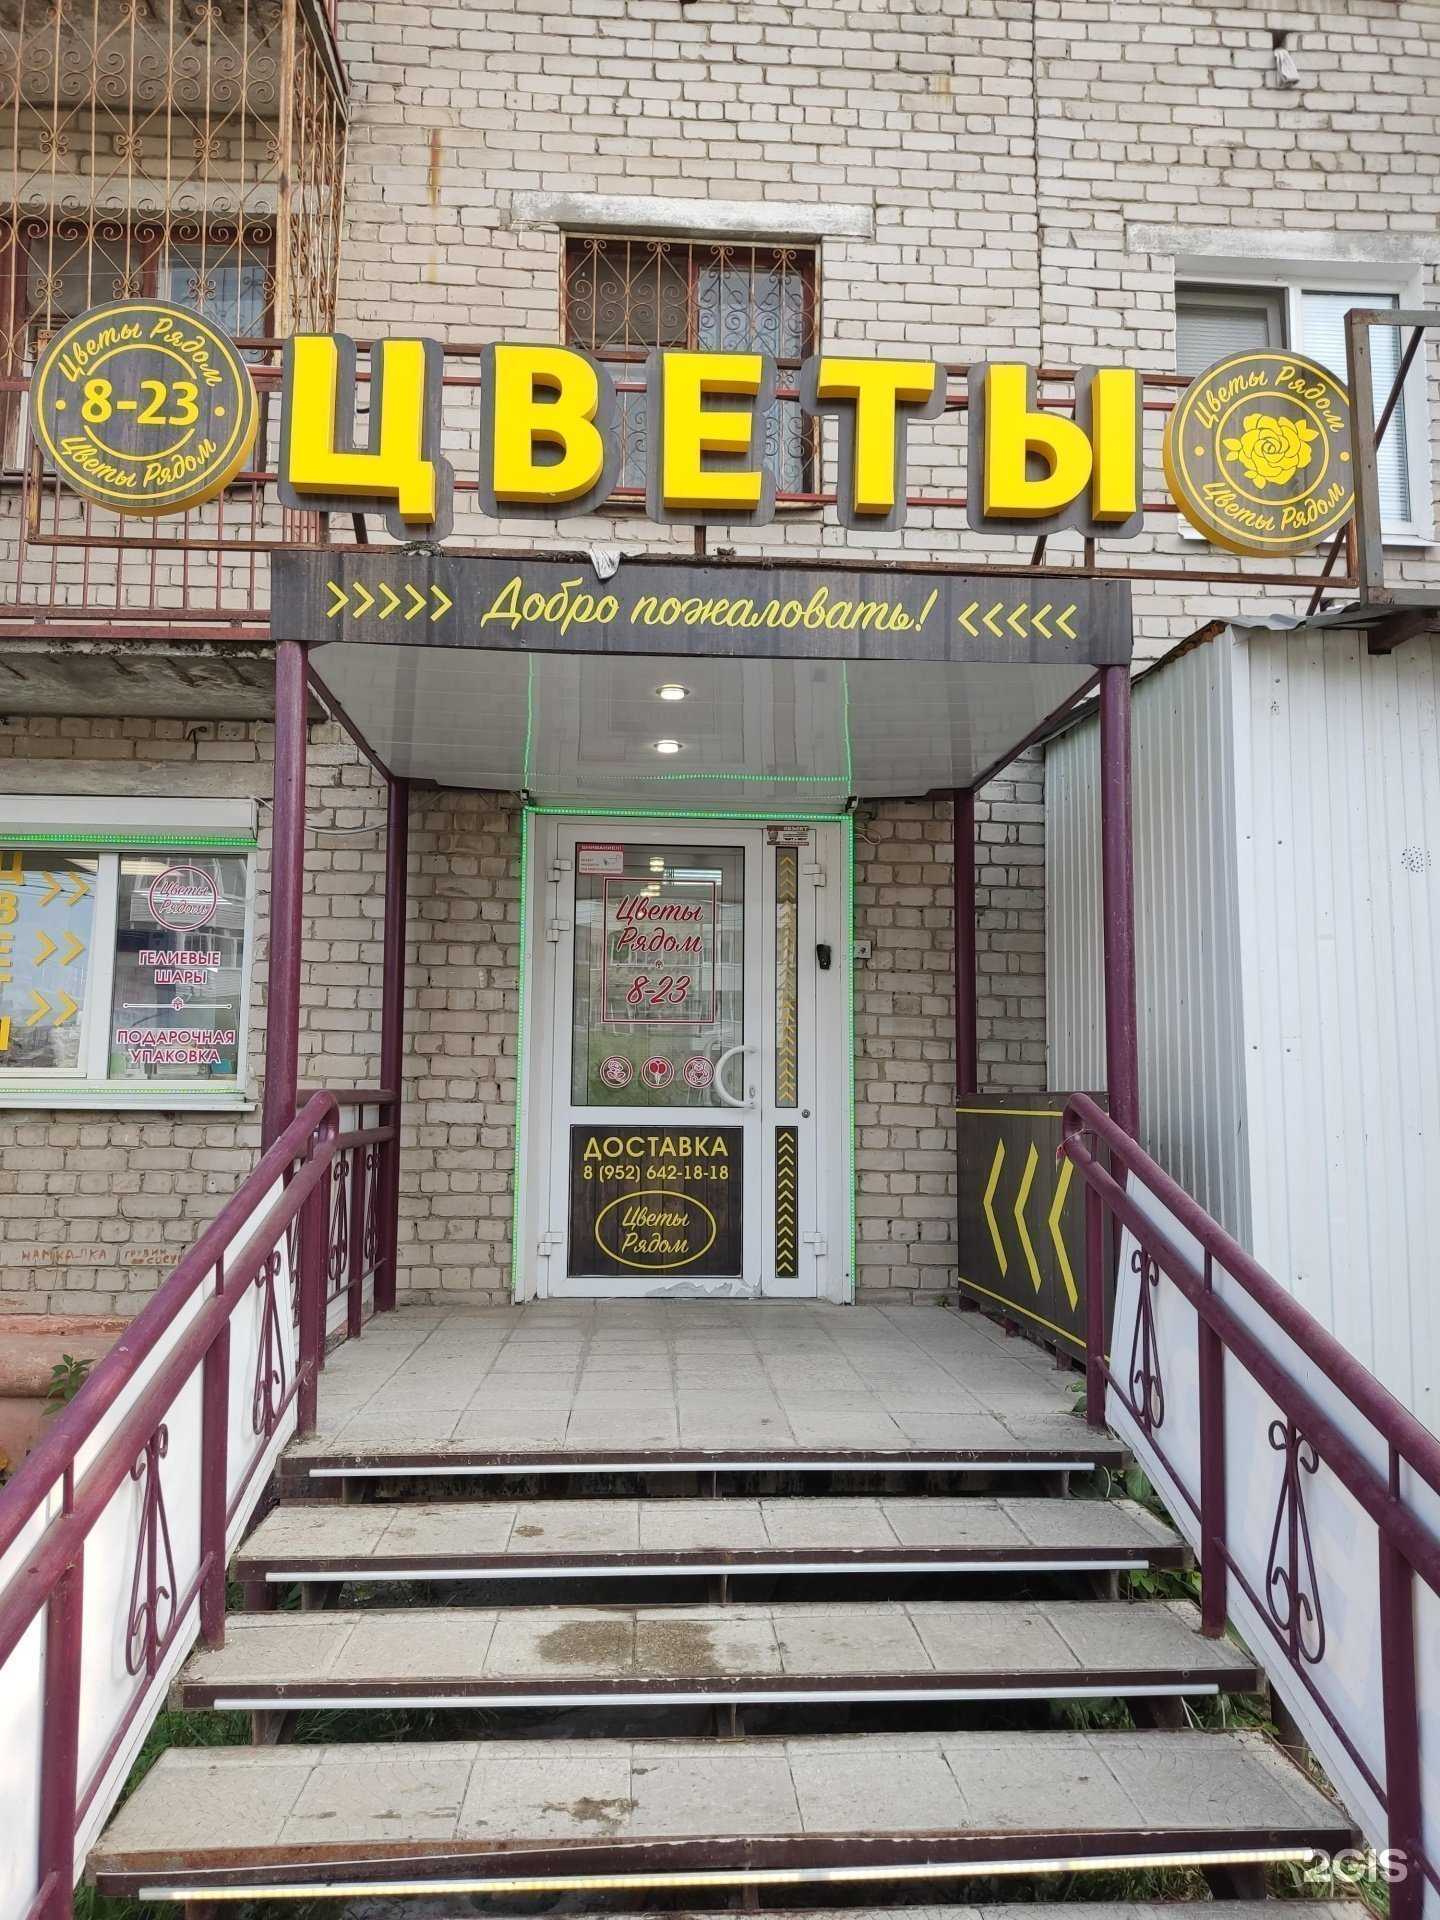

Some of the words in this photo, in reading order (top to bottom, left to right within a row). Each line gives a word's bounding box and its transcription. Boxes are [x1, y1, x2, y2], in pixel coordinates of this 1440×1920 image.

[58, 322, 142, 382] Цветы
[150, 317, 223, 387] Рядом
[81, 378, 199, 425] 8-23
[1194, 370, 1268, 429] Цветы
[1275, 365, 1345, 433] Рядом
[288, 335, 1137, 525] ЦВЕТЫ
[60, 436, 137, 488] Цветы
[143, 438, 216, 488] Рядом
[1202, 482, 1275, 531] Цветы
[1280, 482, 1345, 531] Рядом
[480, 576, 620, 637] Добро
[630, 587, 939, 633] пожаловать!
[159, 880, 209, 898] Цветы
[158, 899, 208, 916] Рядом
[615, 896, 704, 924] Цветы
[617, 926, 703, 953] Рядом
[139, 951, 221, 966] ГЕЛИЕВЫЕ
[154, 970, 207, 985] ШАРЫ
[626, 974, 692, 1004] 8-23
[116, 1029, 236, 1047] ПОДАРОЧНАЯ
[128, 1049, 222, 1064] УПАКОВКА
[583, 1136, 728, 1161] ДОСТАВКА
[583, 1166, 593, 1180] 8
[599, 1165, 641, 1183] (952)
[646, 1166, 729, 1180] 642-18-18
[622, 1205, 690, 1230] Цветы
[621, 1232, 688, 1255] Рядом
